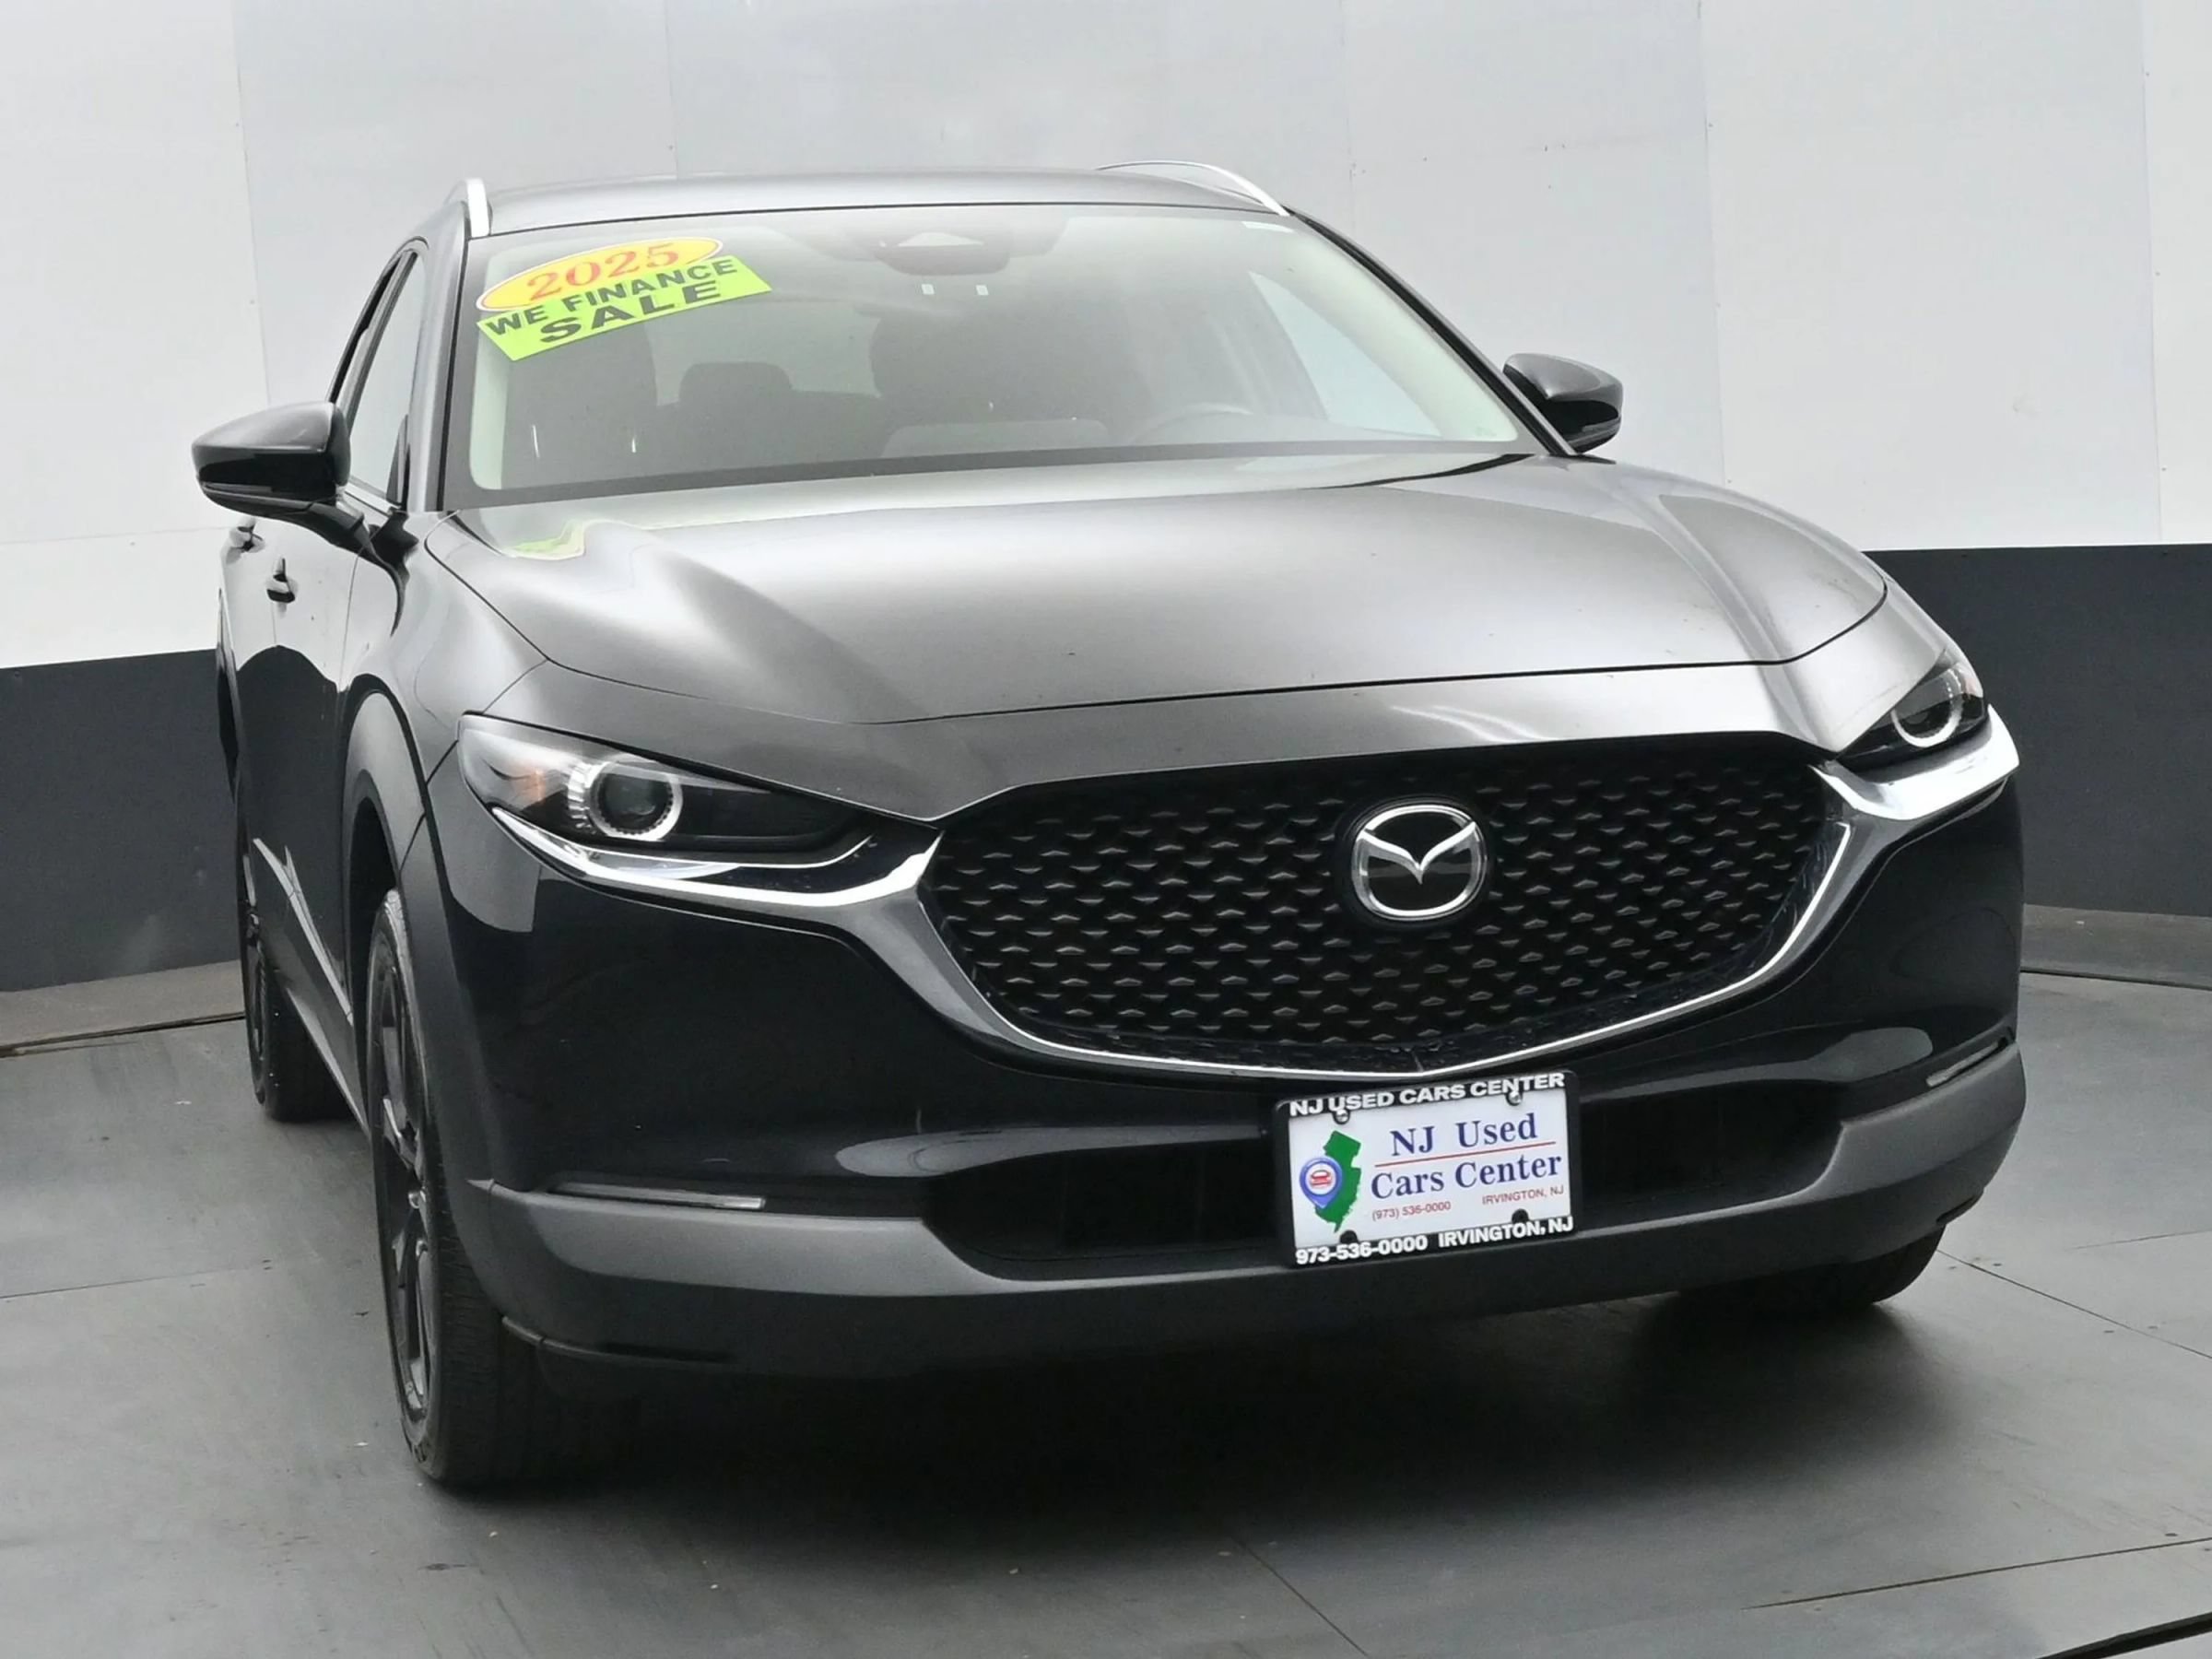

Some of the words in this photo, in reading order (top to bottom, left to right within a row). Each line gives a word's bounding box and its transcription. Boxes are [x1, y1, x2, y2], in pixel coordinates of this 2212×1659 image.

[527, 242, 679, 301] 2025
[487, 305, 549, 335] WE
[560, 258, 738, 312] FINANCE
[539, 279, 721, 343] SALE
[1289, 1100, 1324, 1117] NJ
[1328, 1092, 1394, 1113] USED
[1398, 1084, 1466, 1105] CARS
[1470, 1072, 1566, 1097] CENTER
[1390, 1125, 1435, 1156] NJ
[1456, 1112, 1537, 1149] Used
[1371, 1170, 1444, 1199] Cars
[1454, 1154, 1563, 1189] Center
[1482, 1188, 1547, 1206] IRVINGTON,
[1549, 1184, 1564, 1197] NJ
[1371, 1206, 1400, 1221] (973)
[1402, 1201, 1452, 1218] 536-0000
[1296, 1234, 1429, 1265] 973-536-0000
[1438, 1219, 1547, 1248] IRVINGTON,
[1547, 1216, 1574, 1233] NJ
